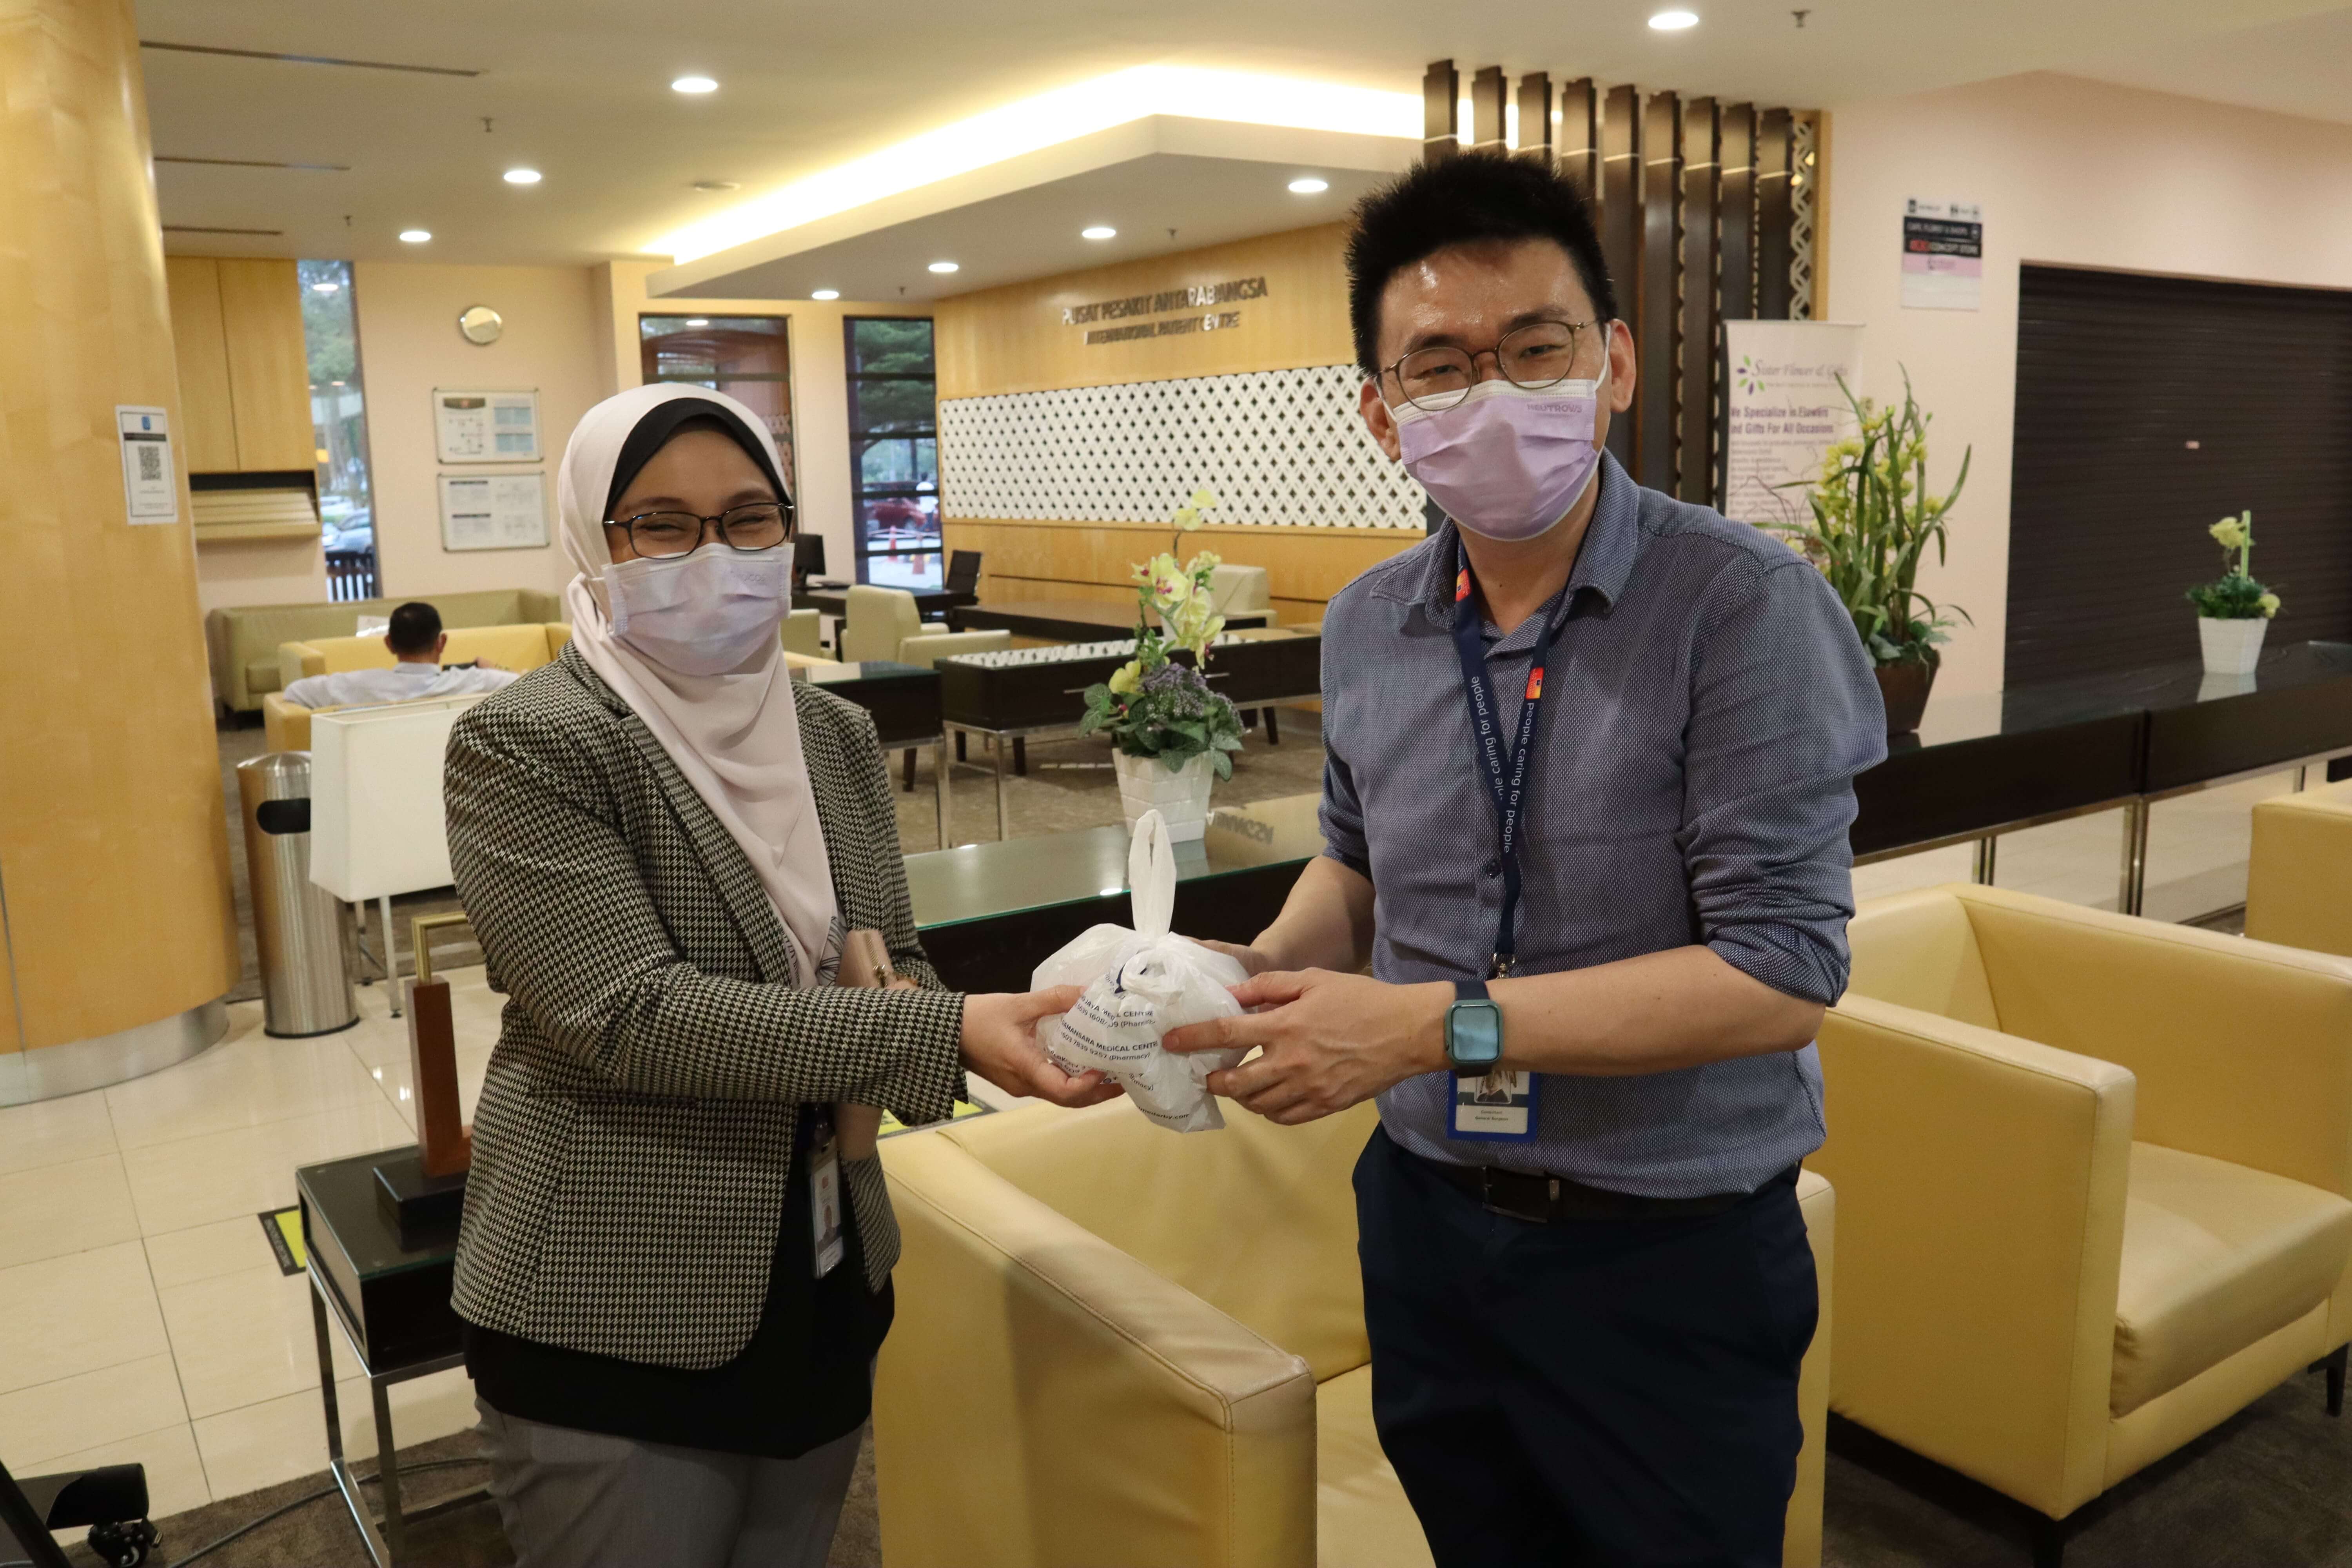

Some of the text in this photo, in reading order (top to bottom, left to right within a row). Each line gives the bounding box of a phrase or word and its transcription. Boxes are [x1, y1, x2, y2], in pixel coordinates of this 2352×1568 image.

[1470, 675, 1490, 716] people
[1480, 719, 1492, 735] for
[1521, 702, 1535, 745] people
[1485, 737, 1501, 774] caring
[1511, 748, 1526, 786] caring
[1510, 789, 1521, 807] for
[1503, 810, 1515, 853] people
[1096, 1042, 1130, 1052] MEDICAL
[1109, 1051, 1151, 1061] (Pharmacy)
